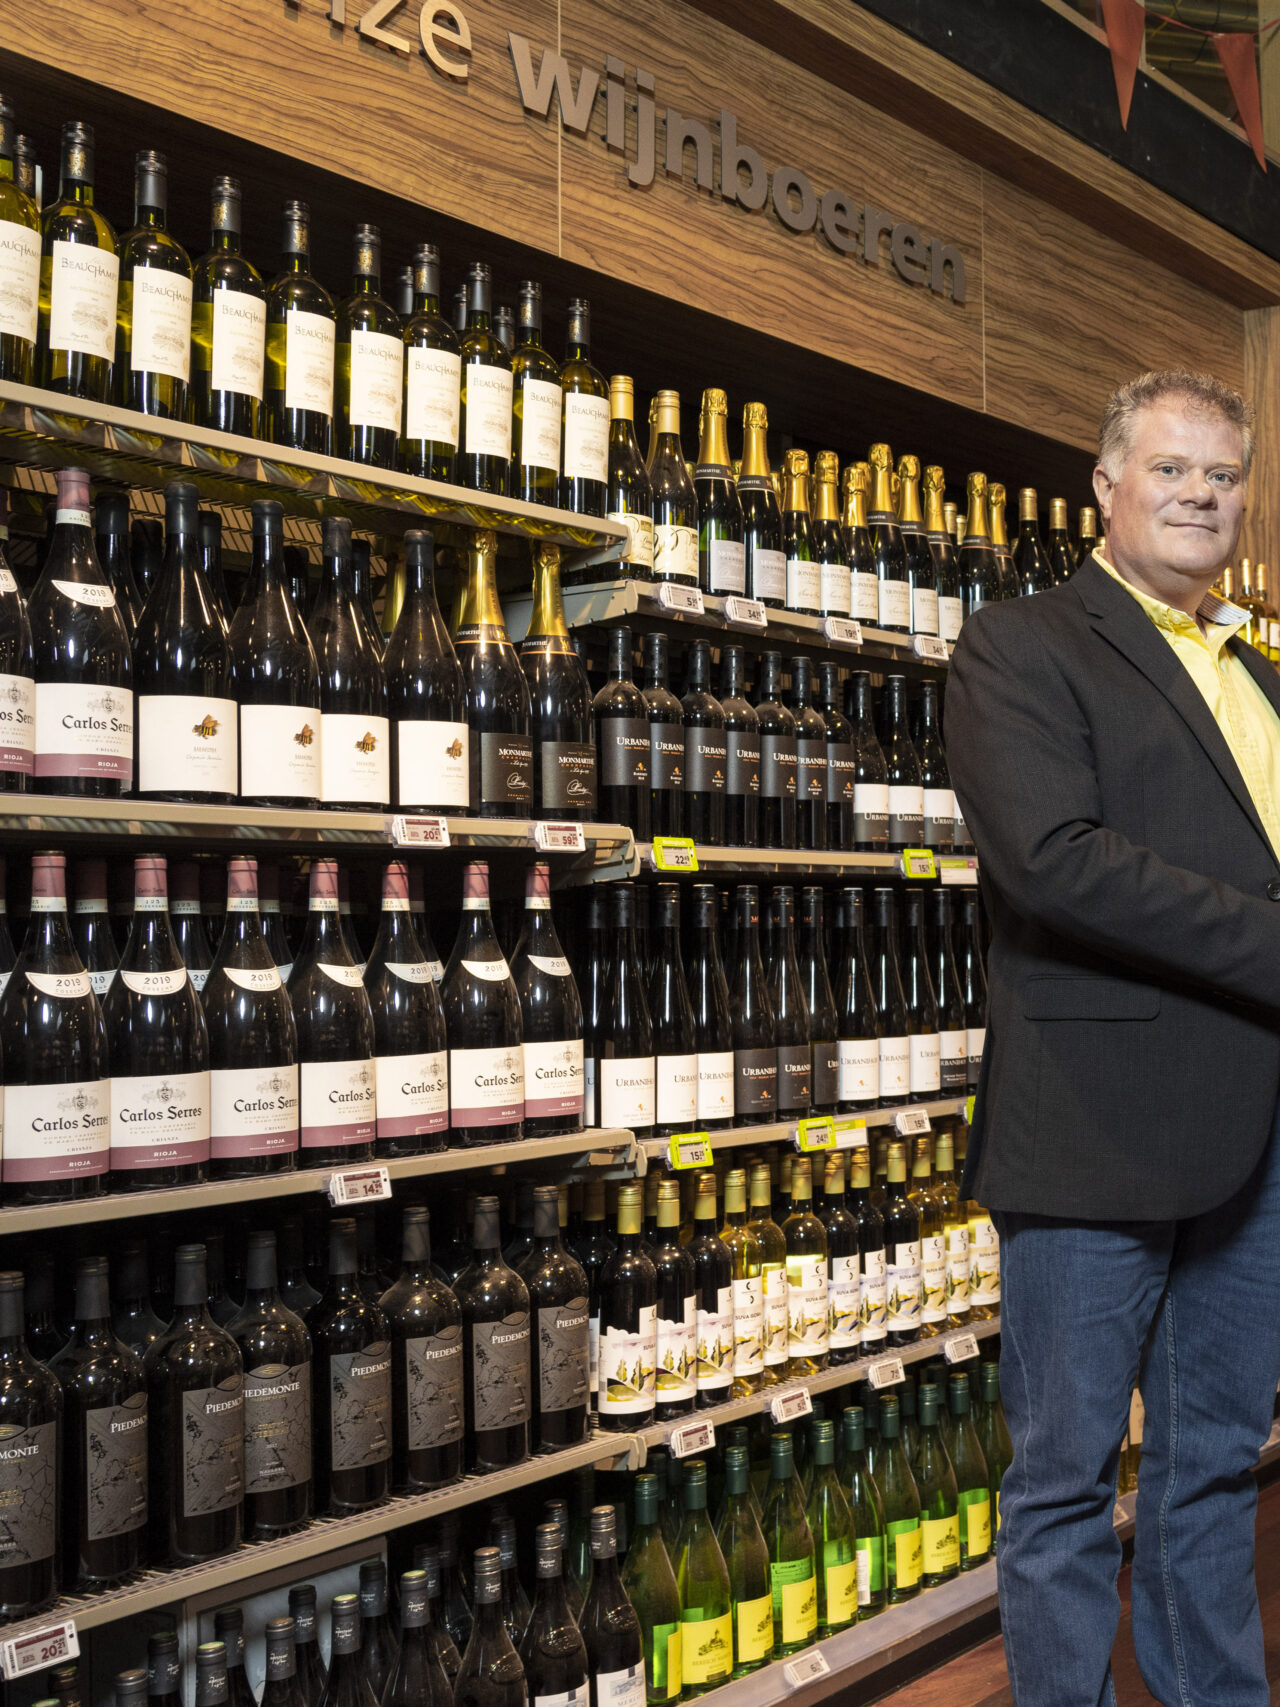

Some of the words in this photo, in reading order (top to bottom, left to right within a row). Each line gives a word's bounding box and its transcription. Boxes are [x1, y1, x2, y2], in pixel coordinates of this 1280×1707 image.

[506, 32, 967, 301] wijnboeren
[62, 714, 107, 730] Carlos
[97, 761, 119, 769] RIOJA
[56, 978, 81, 988] 2019
[144, 976, 171, 985] 2019
[251, 973, 273, 982] 2019
[535, 1067, 567, 1080] Carlos
[474, 1075, 508, 1088] Carlos
[401, 1082, 435, 1096] Carlos
[328, 1090, 364, 1104] Carlos
[233, 1098, 275, 1113] Carlos
[119, 1108, 164, 1123] Carlos
[167, 1105, 202, 1120] Serres
[31, 1116, 79, 1133] Carlos
[69, 1160, 92, 1168] RIOJA
